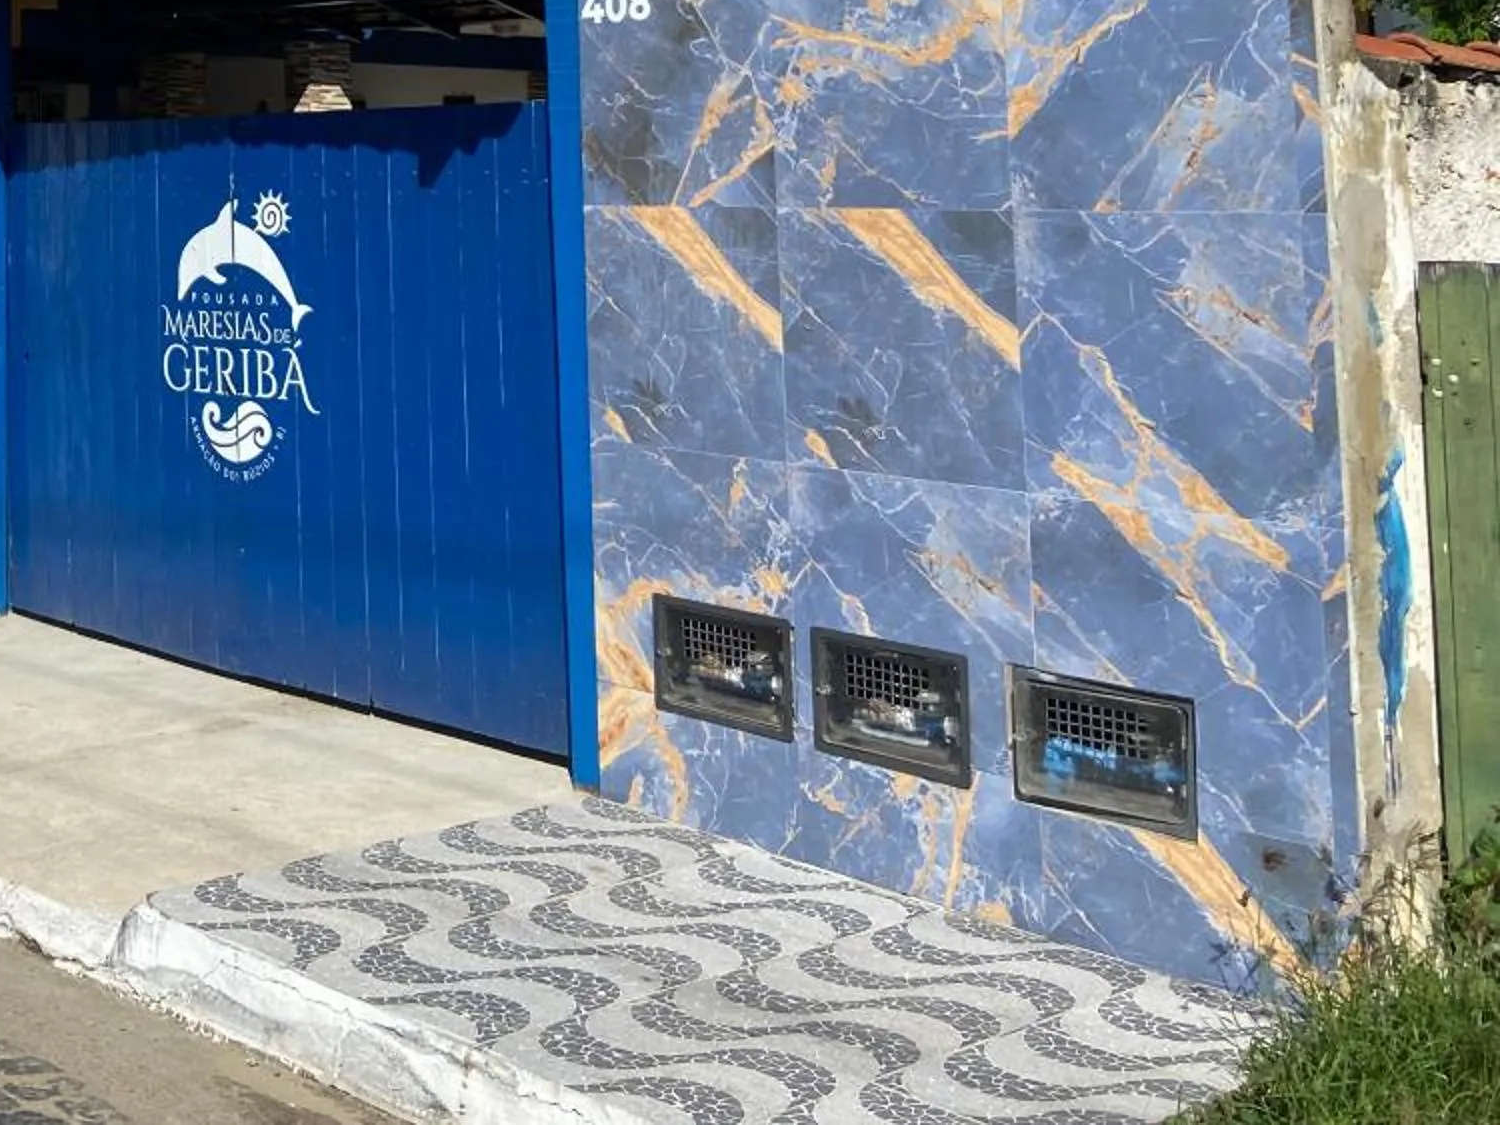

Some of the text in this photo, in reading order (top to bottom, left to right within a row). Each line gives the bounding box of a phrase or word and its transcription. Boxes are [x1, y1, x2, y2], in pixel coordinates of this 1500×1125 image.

[191, 292, 279, 306] POUSADA
[161, 305, 292, 344] MARESIAS DE
[163, 338, 321, 415] GERIBÁ
